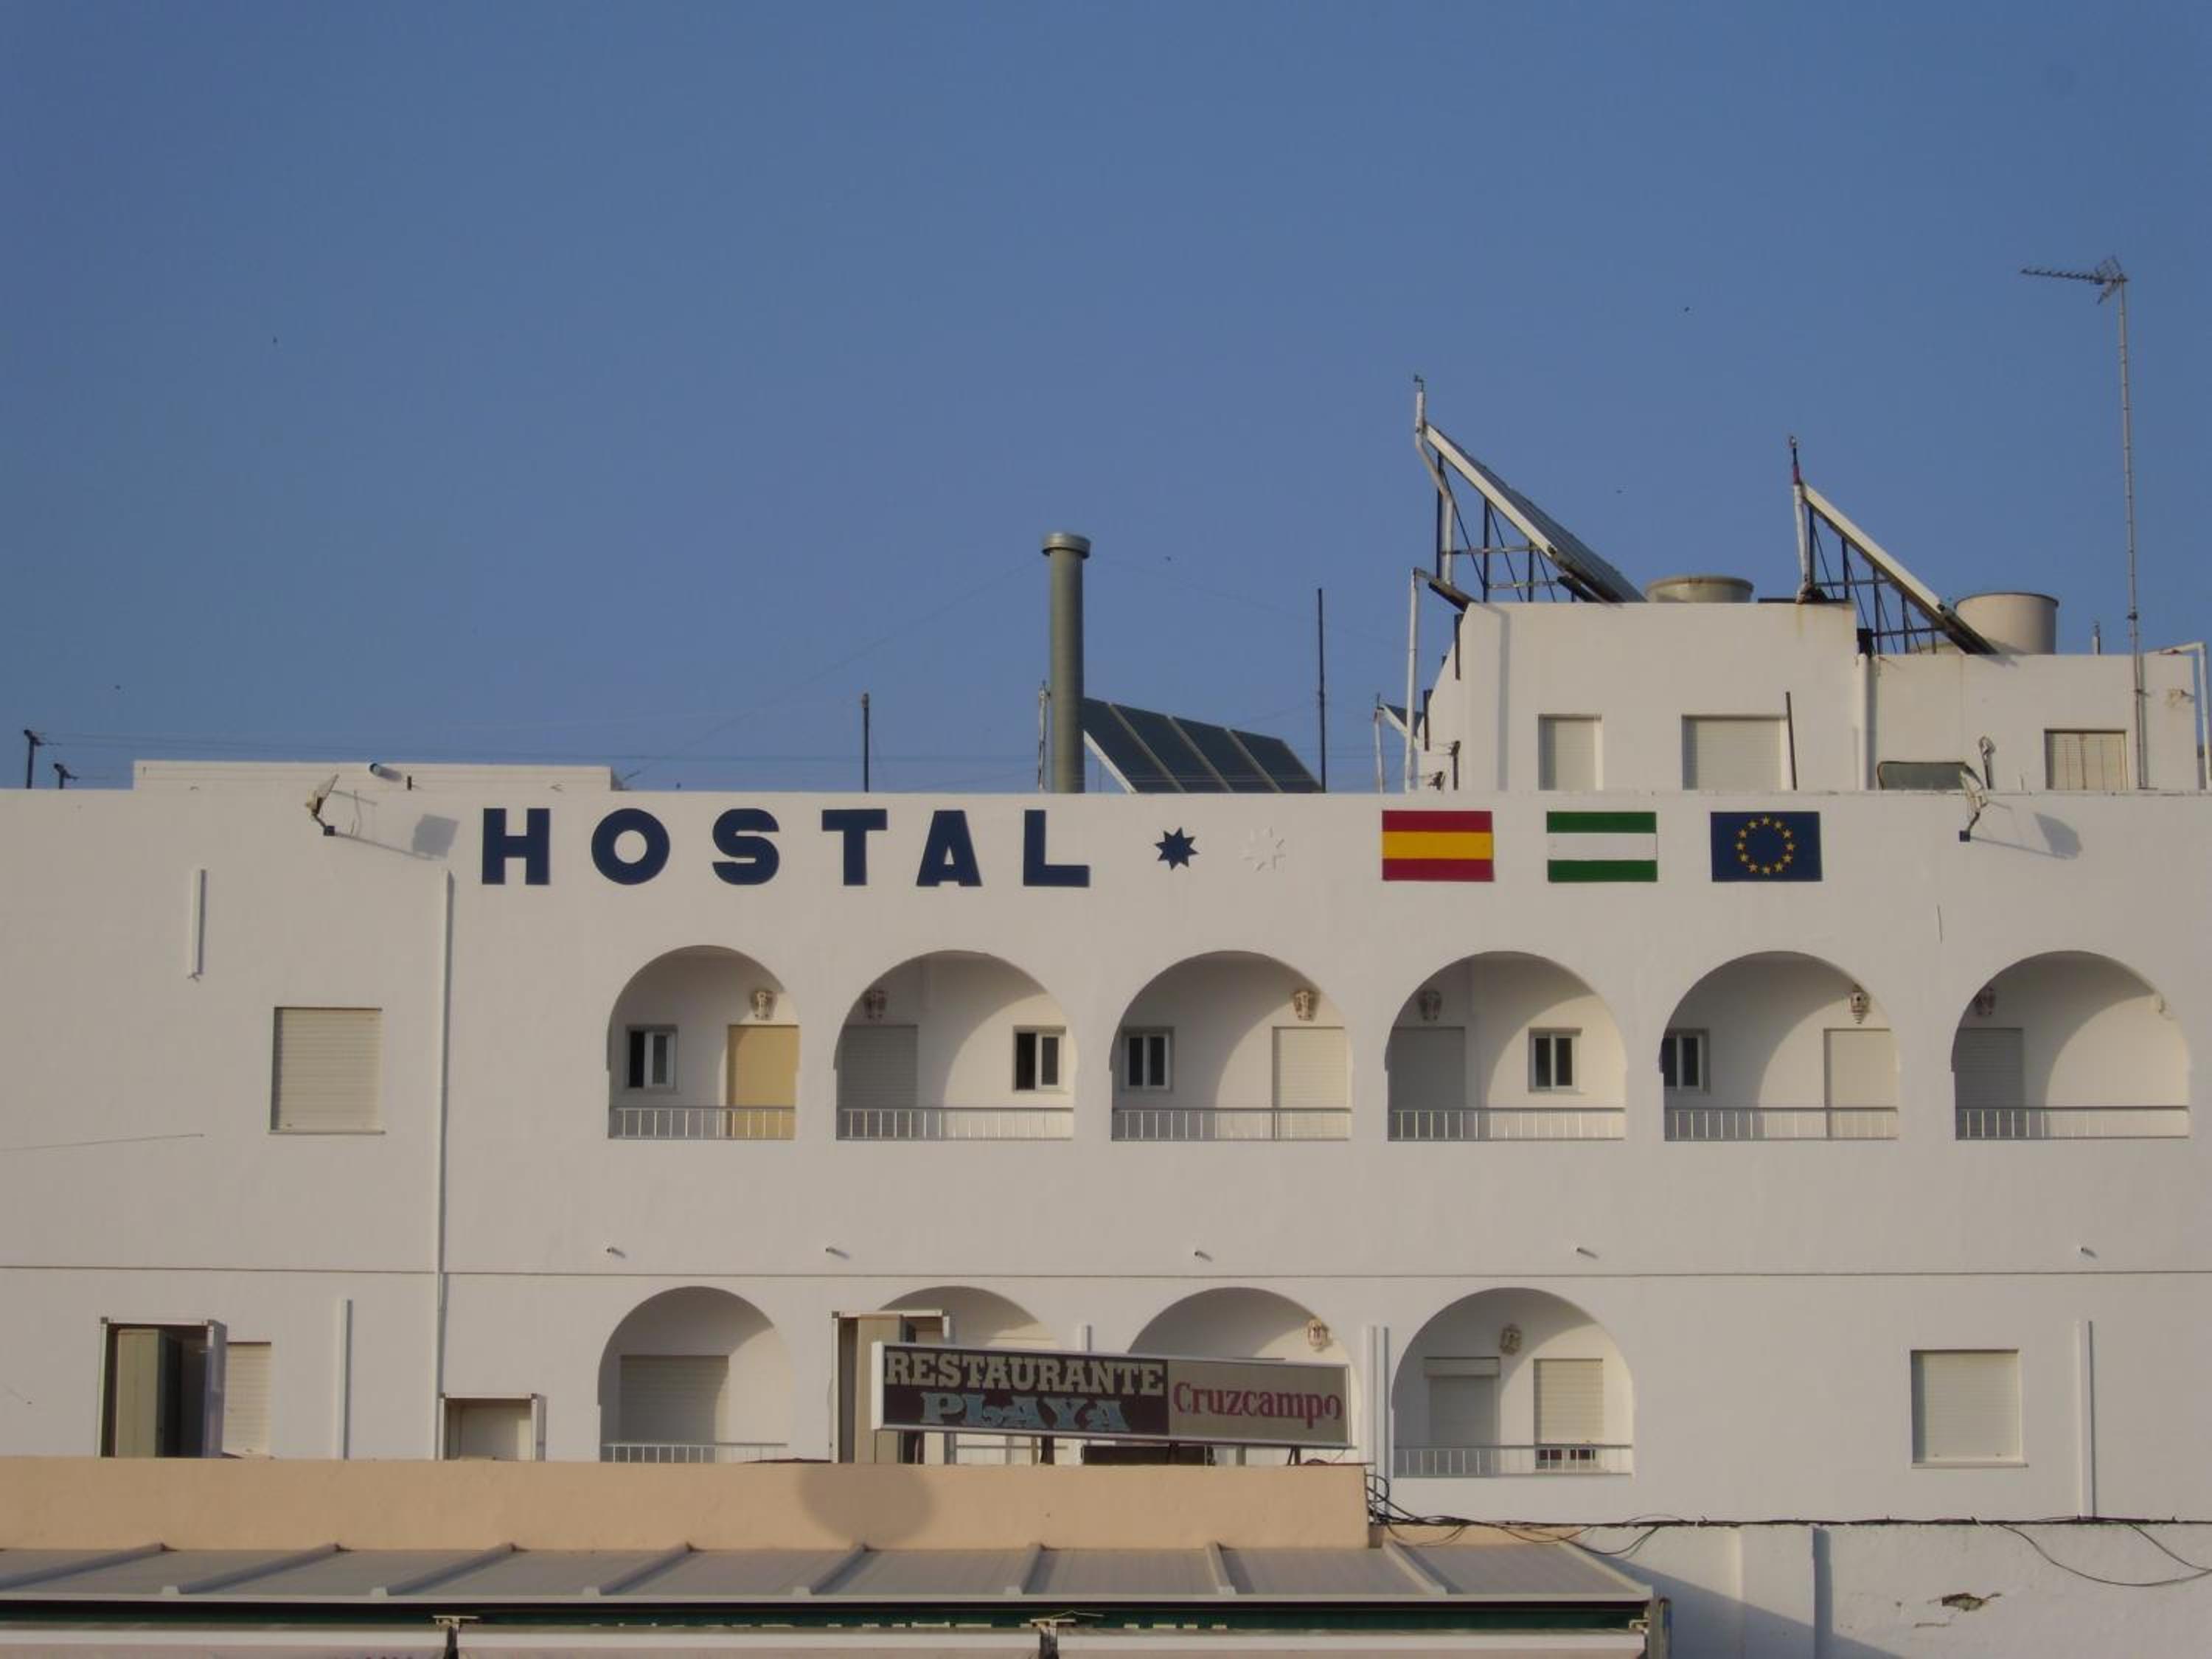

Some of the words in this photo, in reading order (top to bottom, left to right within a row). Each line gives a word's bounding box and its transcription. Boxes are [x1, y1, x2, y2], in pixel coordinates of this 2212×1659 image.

[481, 807, 1090, 888] HOSTAL
[885, 1351, 1165, 1397] RESTAURANTE
[920, 1391, 1131, 1433] PLAYA
[1172, 1381, 1343, 1429] Cruzcampo
